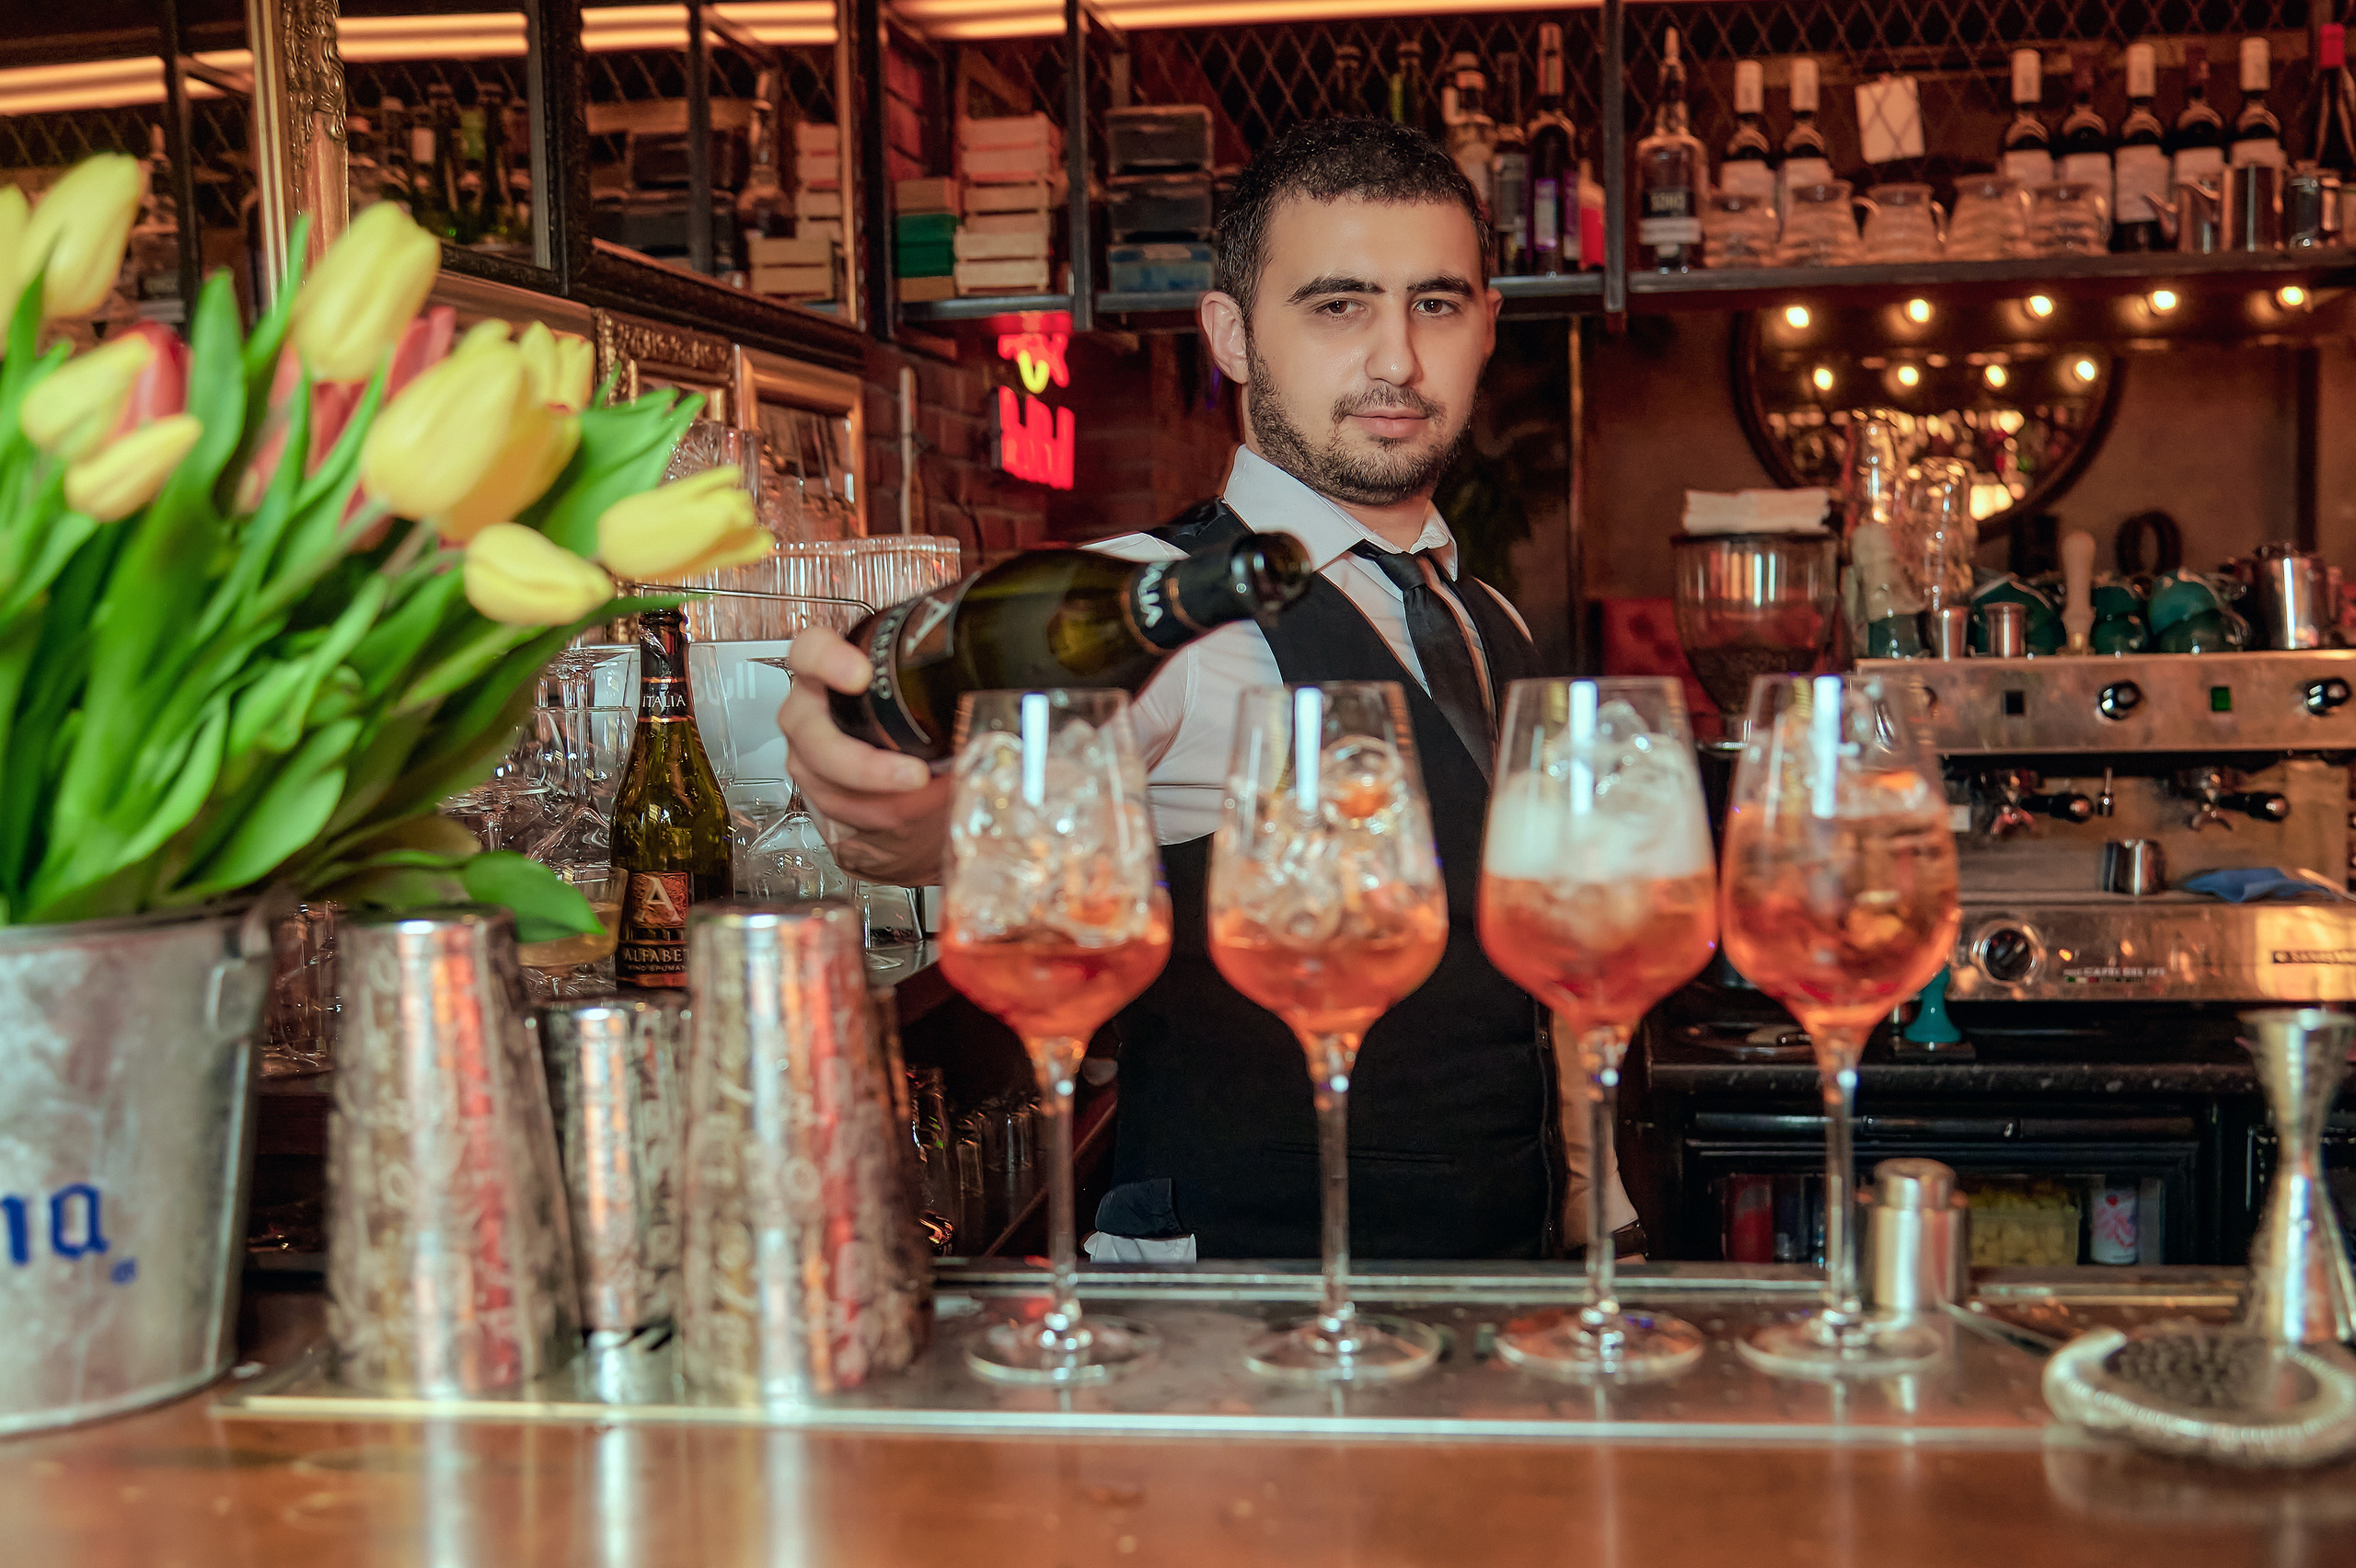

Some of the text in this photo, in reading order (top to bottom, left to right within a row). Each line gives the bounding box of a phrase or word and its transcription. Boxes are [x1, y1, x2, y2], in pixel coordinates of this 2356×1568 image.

[642, 695, 687, 708] ITALIA
[633, 877, 683, 922] A
[624, 947, 690, 963] ALFABET
[649, 963, 687, 973] SPUMAN
